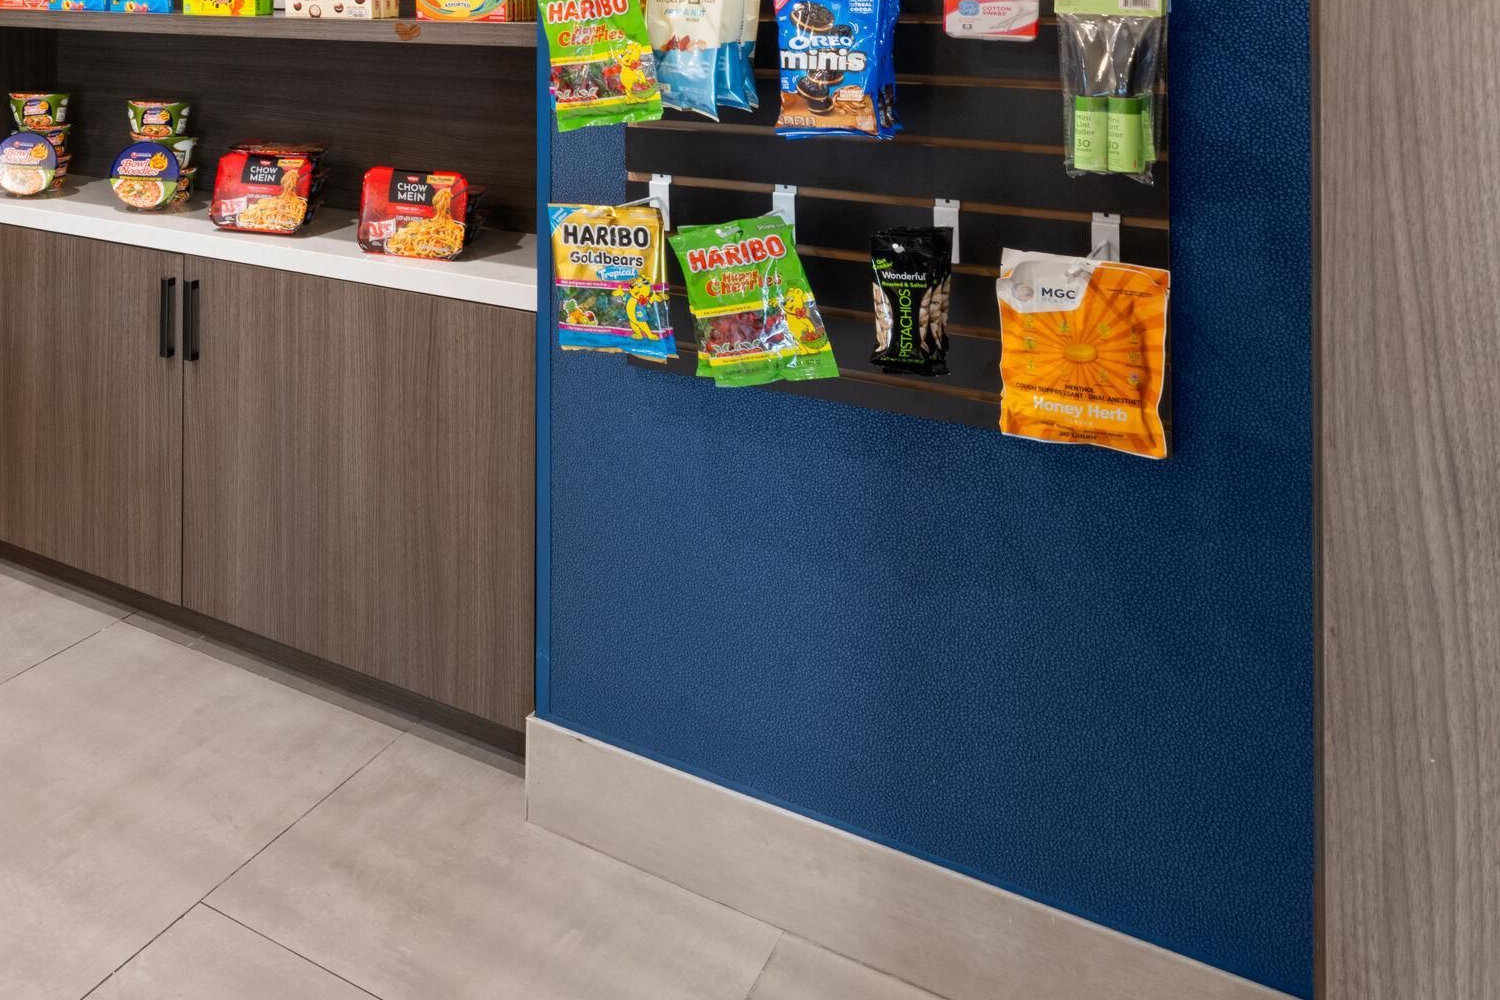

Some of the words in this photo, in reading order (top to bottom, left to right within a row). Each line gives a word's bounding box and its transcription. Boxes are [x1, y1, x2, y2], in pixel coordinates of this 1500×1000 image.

[789, 35, 852, 50] OREO
[781, 49, 866, 71] minis
[1077, 114, 1092, 122] Mini
[1076, 139, 1091, 148] 30
[4, 148, 32, 157] Bowl
[0, 155, 40, 165] Noodles
[121, 159, 150, 168] Bowl
[118, 167, 160, 177] Noodles
[250, 166, 278, 174] CHOW
[250, 174, 276, 182] MEIN
[397, 182, 427, 192] CHOW
[398, 192, 426, 202] MEIN
[563, 224, 649, 248] HARIBO
[688, 235, 786, 271] HARIBO
[570, 251, 643, 267] Goldbears
[598, 268, 636, 280] Tropical
[882, 271, 926, 281] Wonderful
[1041, 287, 1076, 299] MGC
[899, 289, 912, 357] PISTACHIOS
[1016, 382, 1037, 391] COUGH
[1038, 385, 1083, 399] SUPPRESSANT
[1065, 384, 1094, 393] MENTHOL
[1033, 395, 1083, 417] Honey
[1088, 404, 1128, 422] Herb
